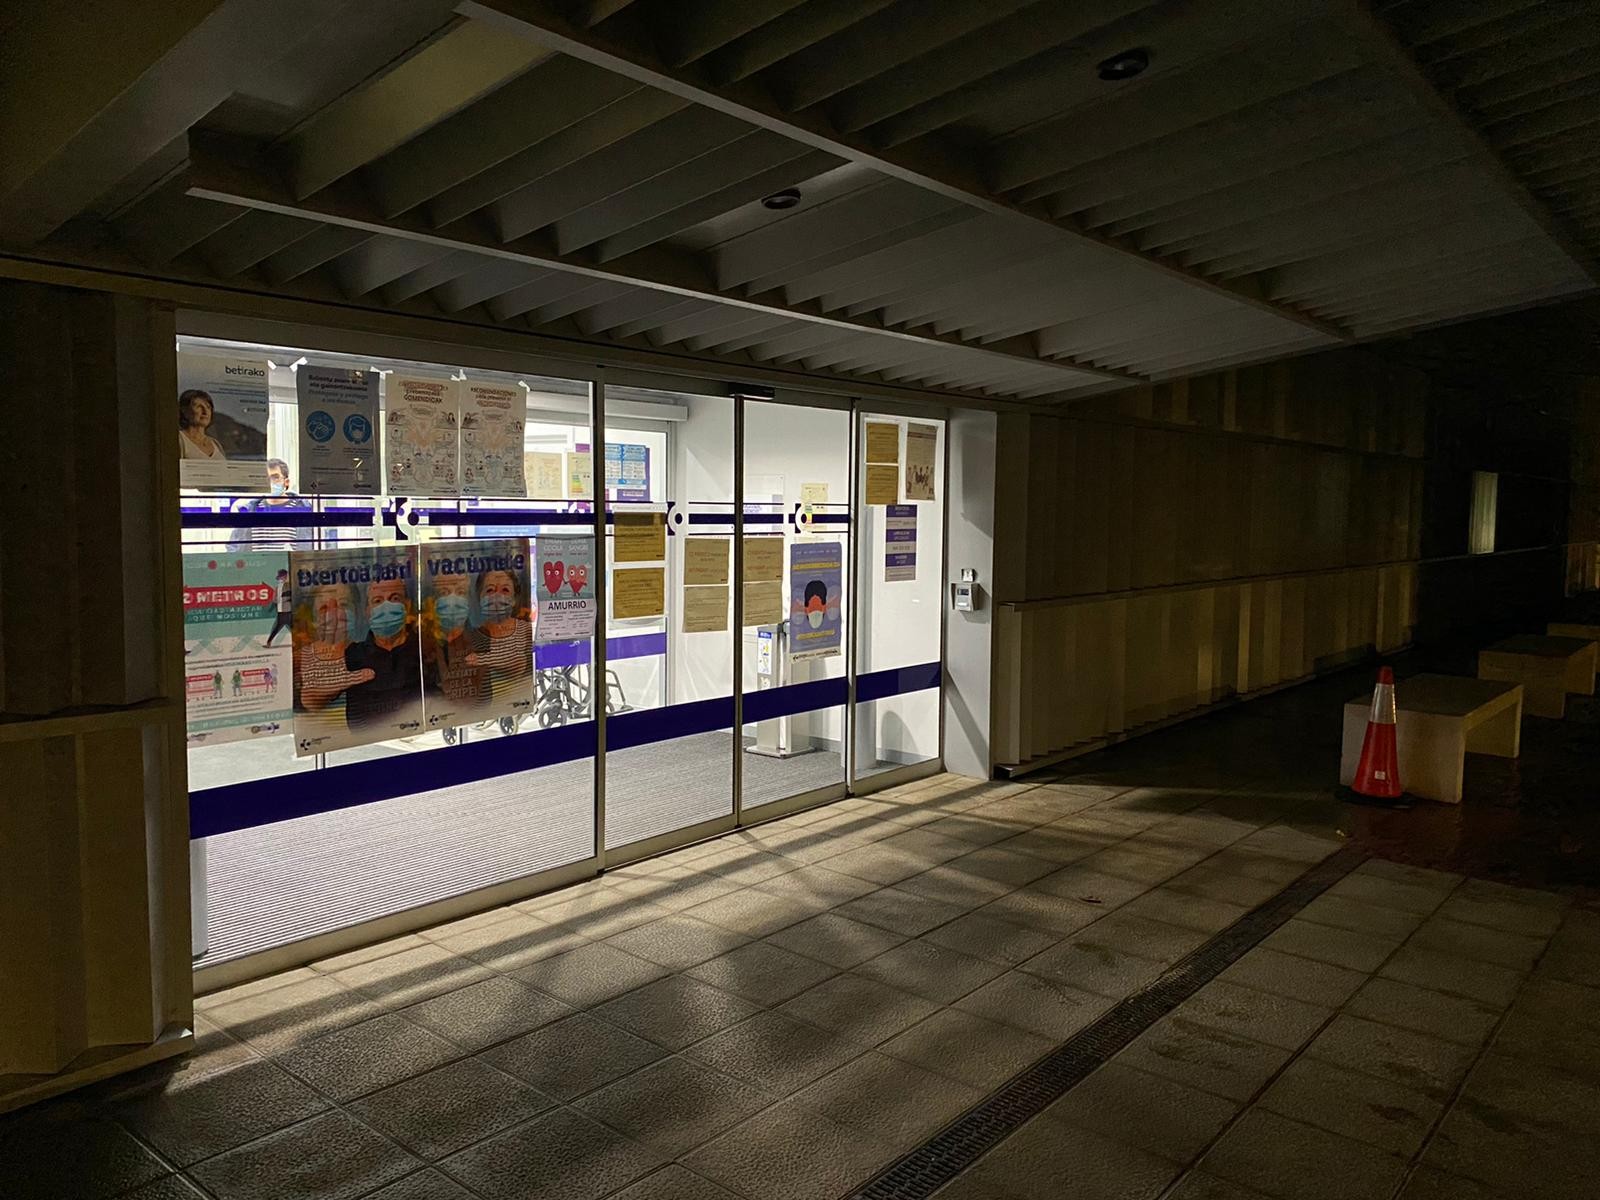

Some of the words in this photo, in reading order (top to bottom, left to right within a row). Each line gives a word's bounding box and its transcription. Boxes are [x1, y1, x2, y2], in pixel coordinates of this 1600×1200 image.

[225, 365, 265, 377] betirako
[196, 588, 269, 603] METROS
[548, 600, 587, 611] AMURRIO
